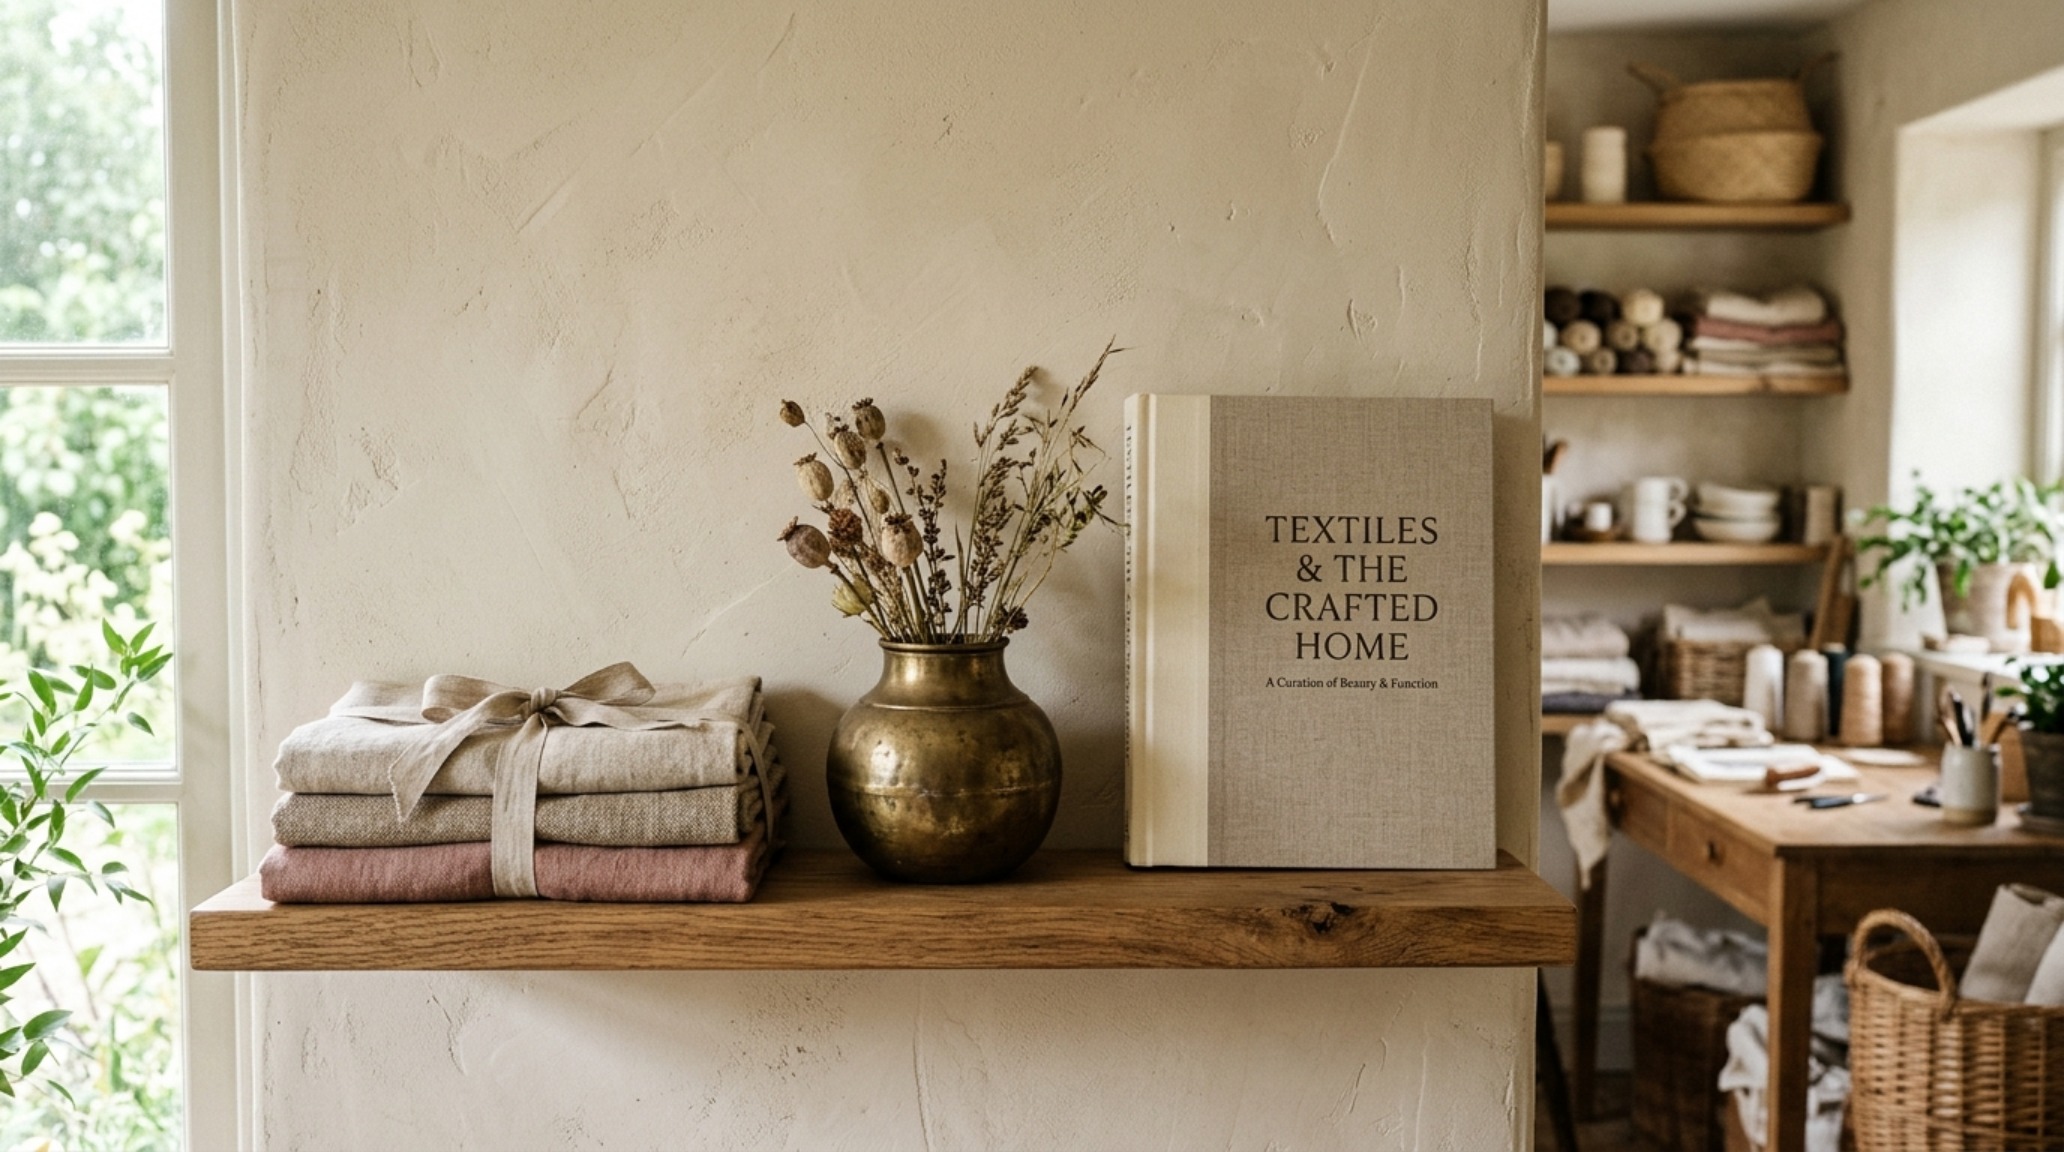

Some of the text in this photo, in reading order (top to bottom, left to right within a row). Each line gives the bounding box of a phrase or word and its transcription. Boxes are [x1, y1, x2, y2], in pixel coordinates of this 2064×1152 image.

[1265, 515, 1438, 545] TEXTILES
[1296, 554, 1408, 583] & THE
[1265, 592, 1438, 621] CRAFTED
[1296, 631, 1409, 660] HOME
[1265, 677, 1438, 691] A Curation of Beauty & Function
